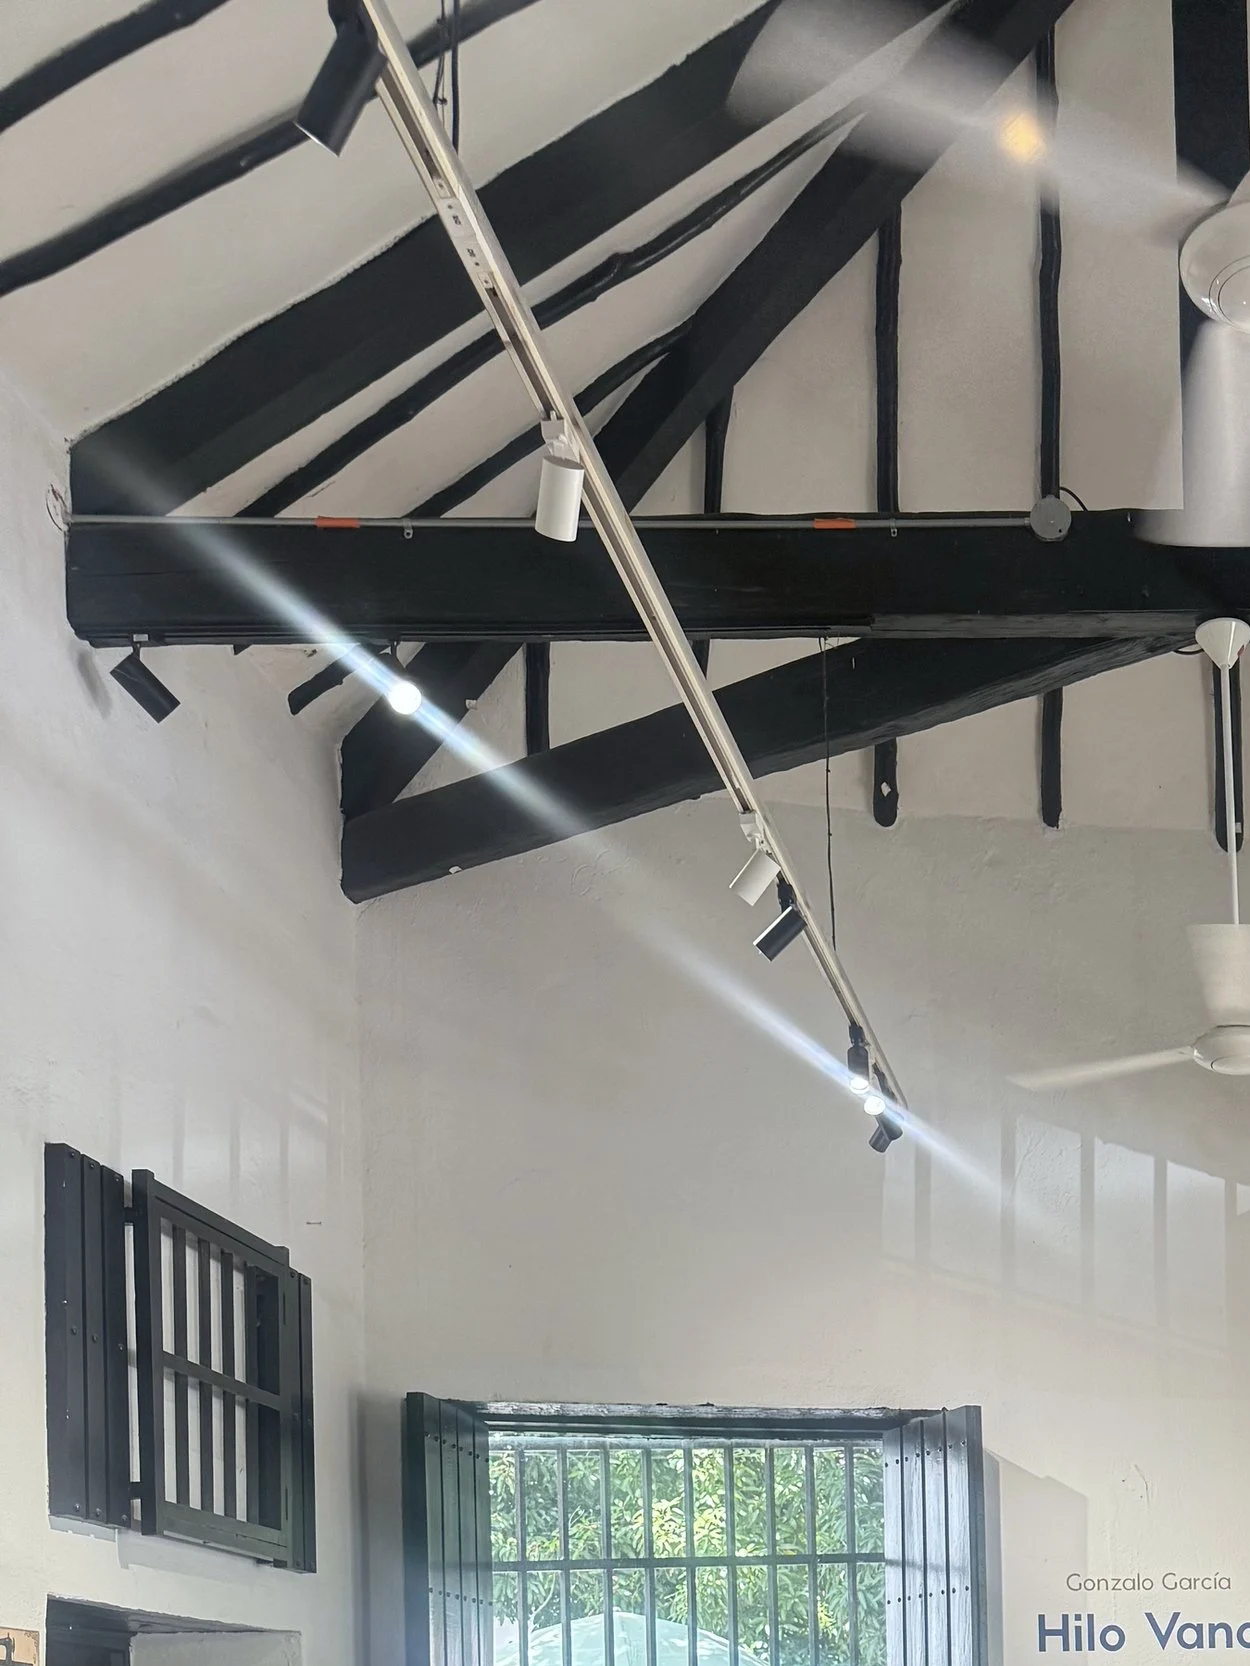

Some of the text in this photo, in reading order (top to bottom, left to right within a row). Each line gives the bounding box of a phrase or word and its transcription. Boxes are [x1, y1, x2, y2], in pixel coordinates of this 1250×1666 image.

[1066, 1571, 1231, 1592] Gonzalo García
[1037, 1613, 1126, 1652] Hilo
